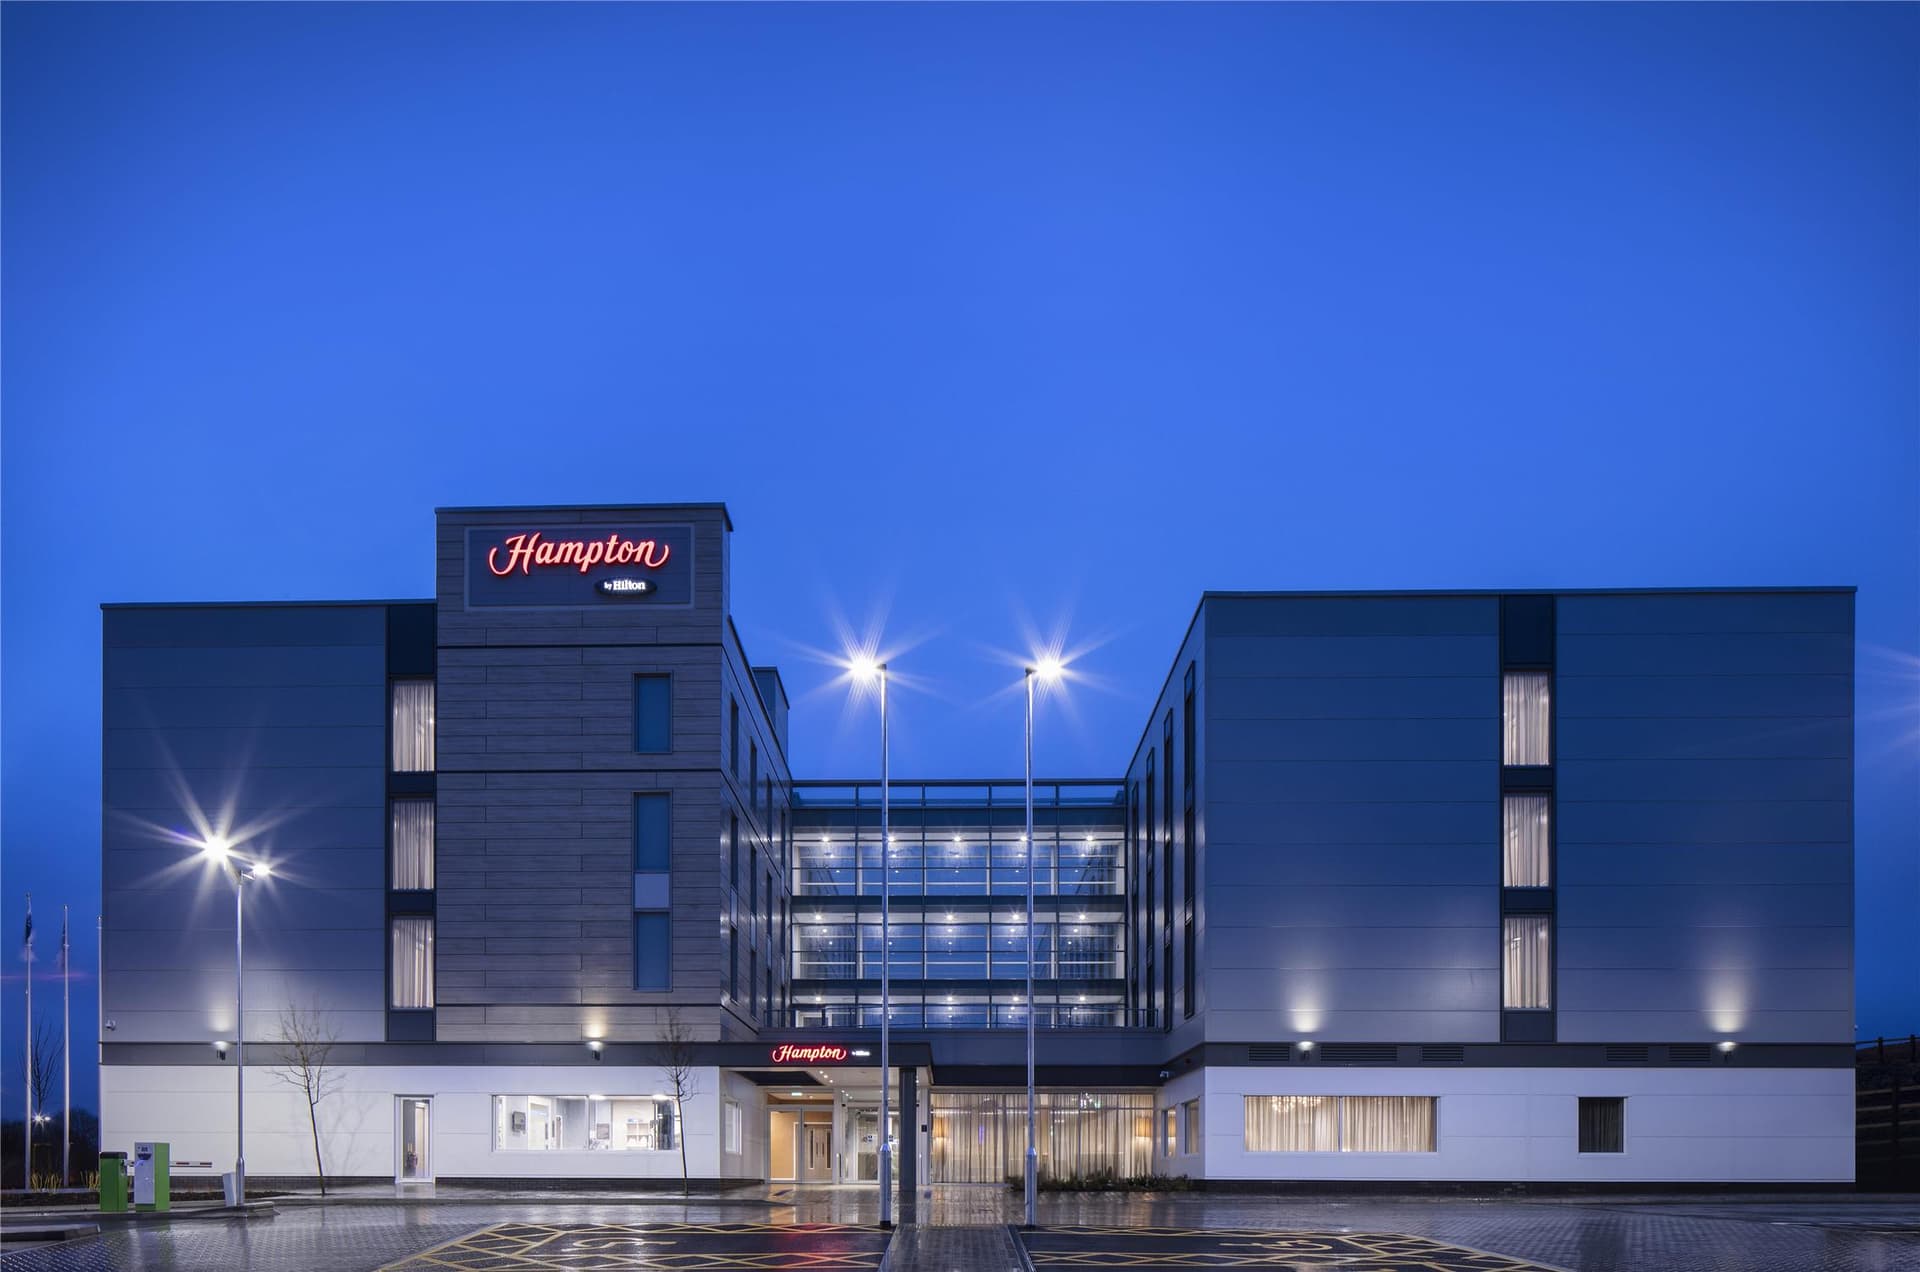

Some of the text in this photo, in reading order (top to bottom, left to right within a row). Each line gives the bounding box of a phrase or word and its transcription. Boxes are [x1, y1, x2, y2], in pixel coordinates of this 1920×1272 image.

[488, 532, 670, 575] Hampton
[603, 579, 646, 591] by Hilton
[772, 1045, 847, 1062] Hampton
